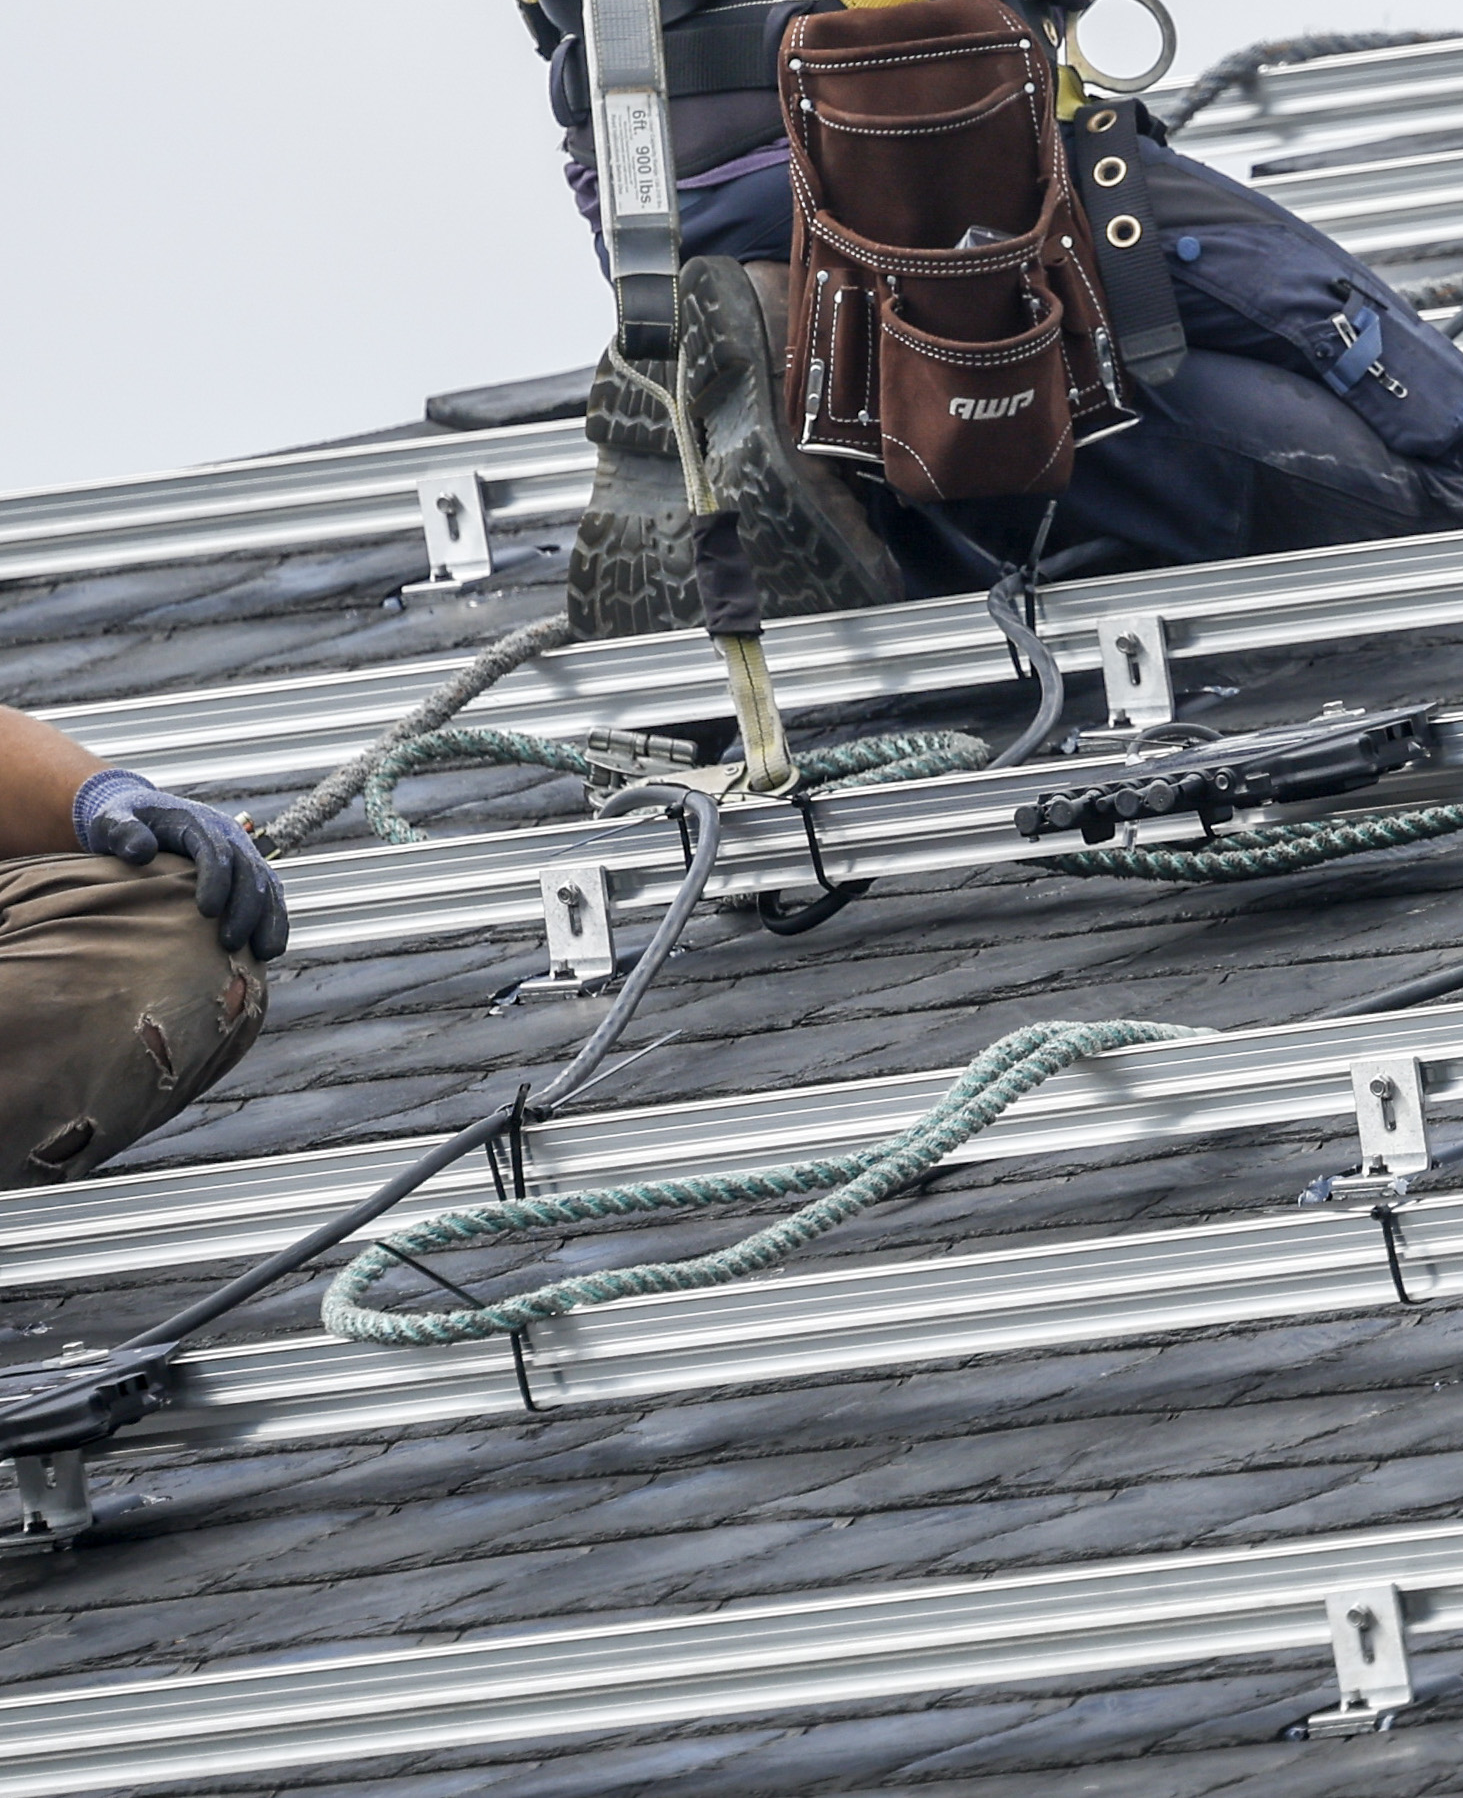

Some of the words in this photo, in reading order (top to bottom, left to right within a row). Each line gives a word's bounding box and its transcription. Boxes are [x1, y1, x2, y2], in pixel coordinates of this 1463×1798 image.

[632, 109, 647, 136] 6ft.
[635, 145, 652, 175] 900
[638, 179, 654, 209] lbs.
[949, 388, 1035, 421] AWP
